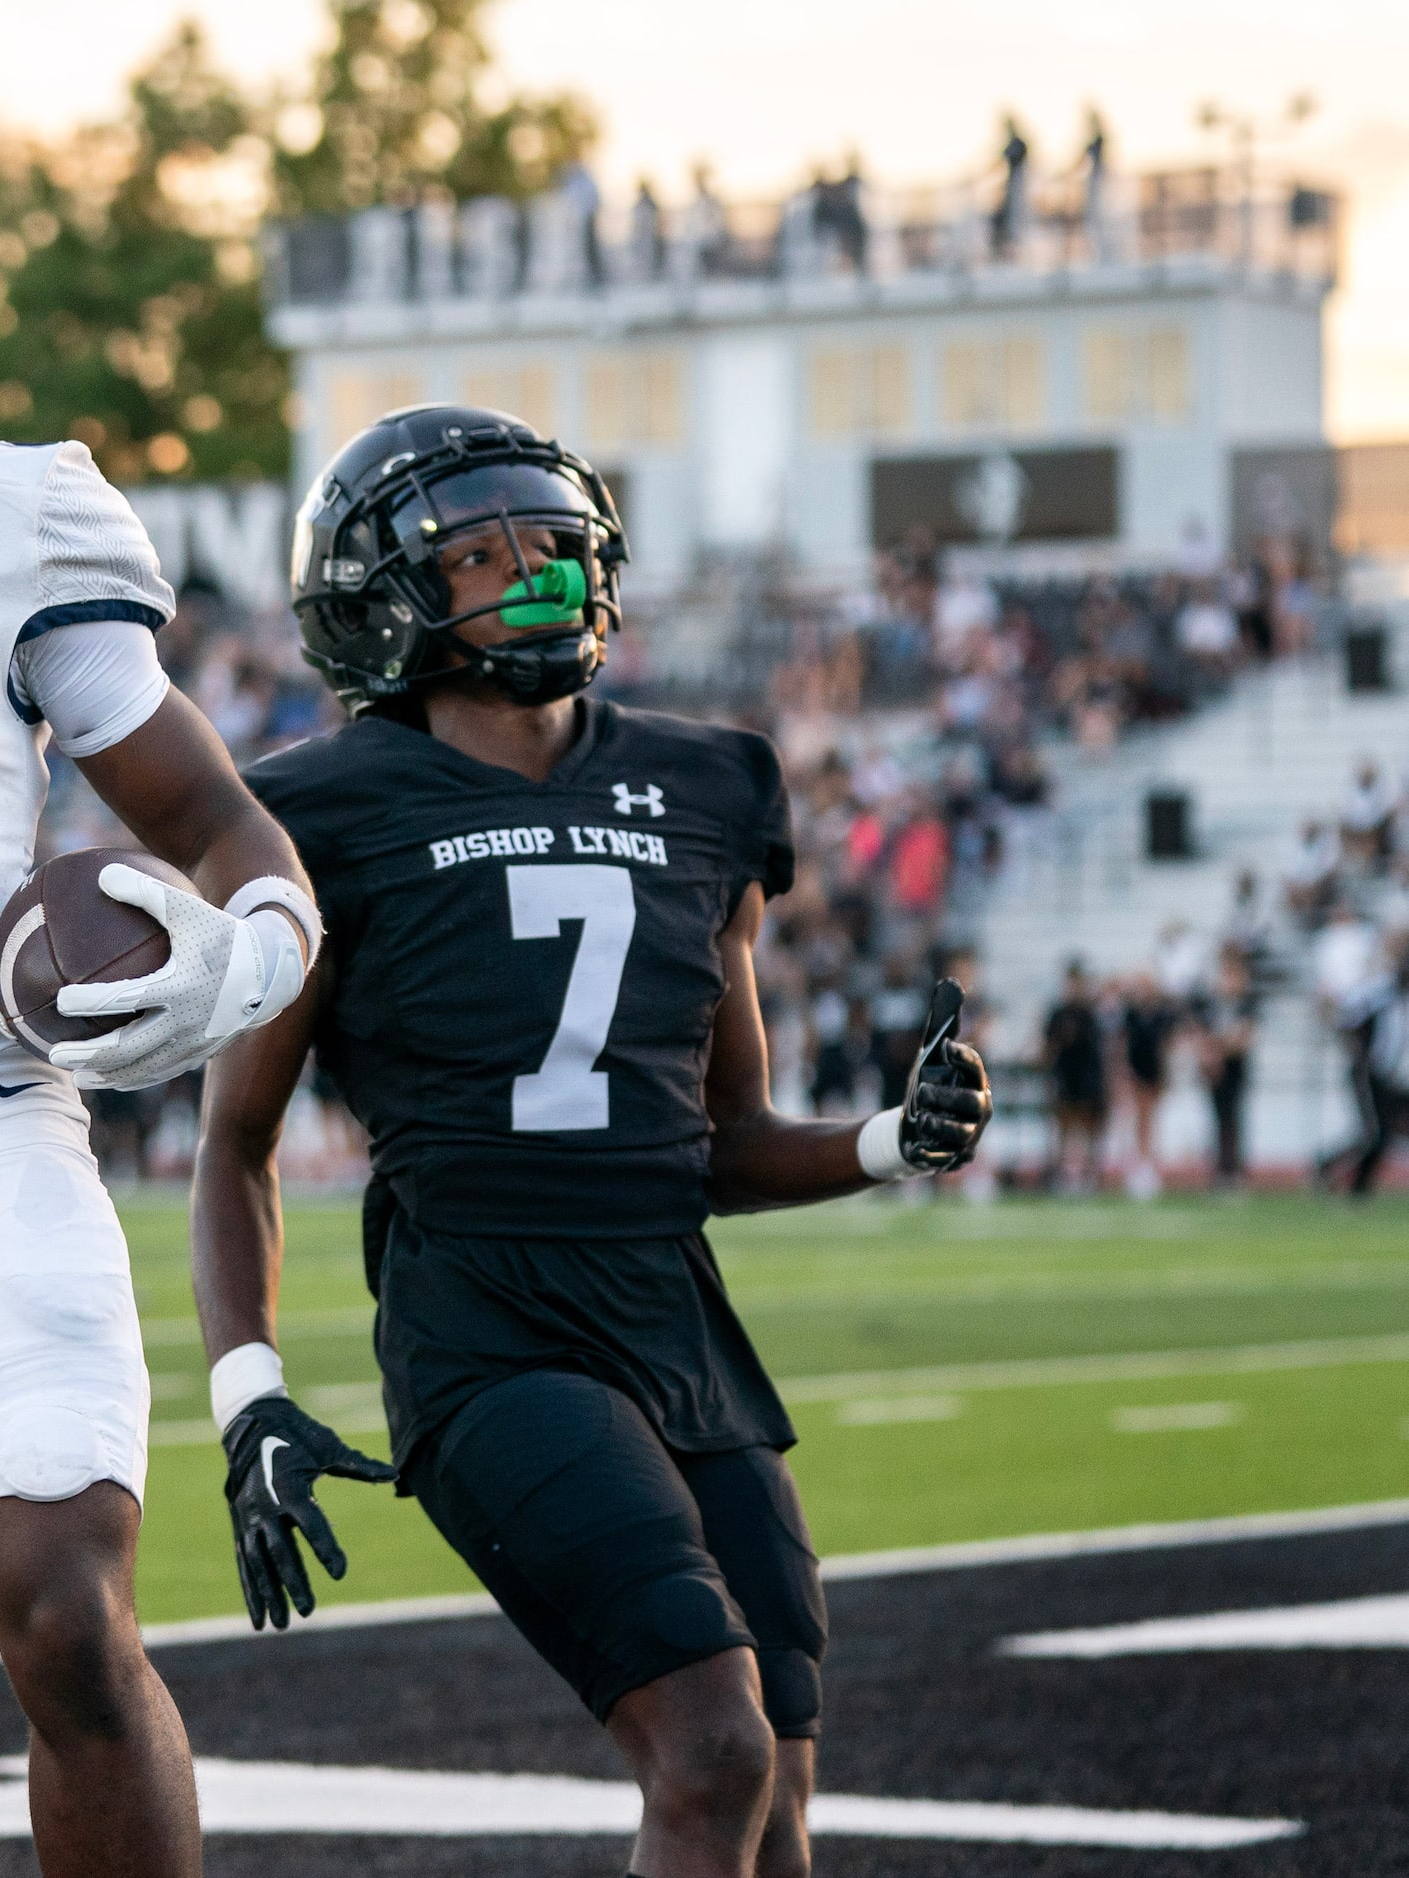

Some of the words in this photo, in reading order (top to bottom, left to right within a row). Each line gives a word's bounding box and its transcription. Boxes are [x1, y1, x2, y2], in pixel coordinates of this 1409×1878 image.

[429, 827, 555, 870] BISHOP
[567, 826, 669, 867] LYNCH
[506, 864, 637, 1132] 7
